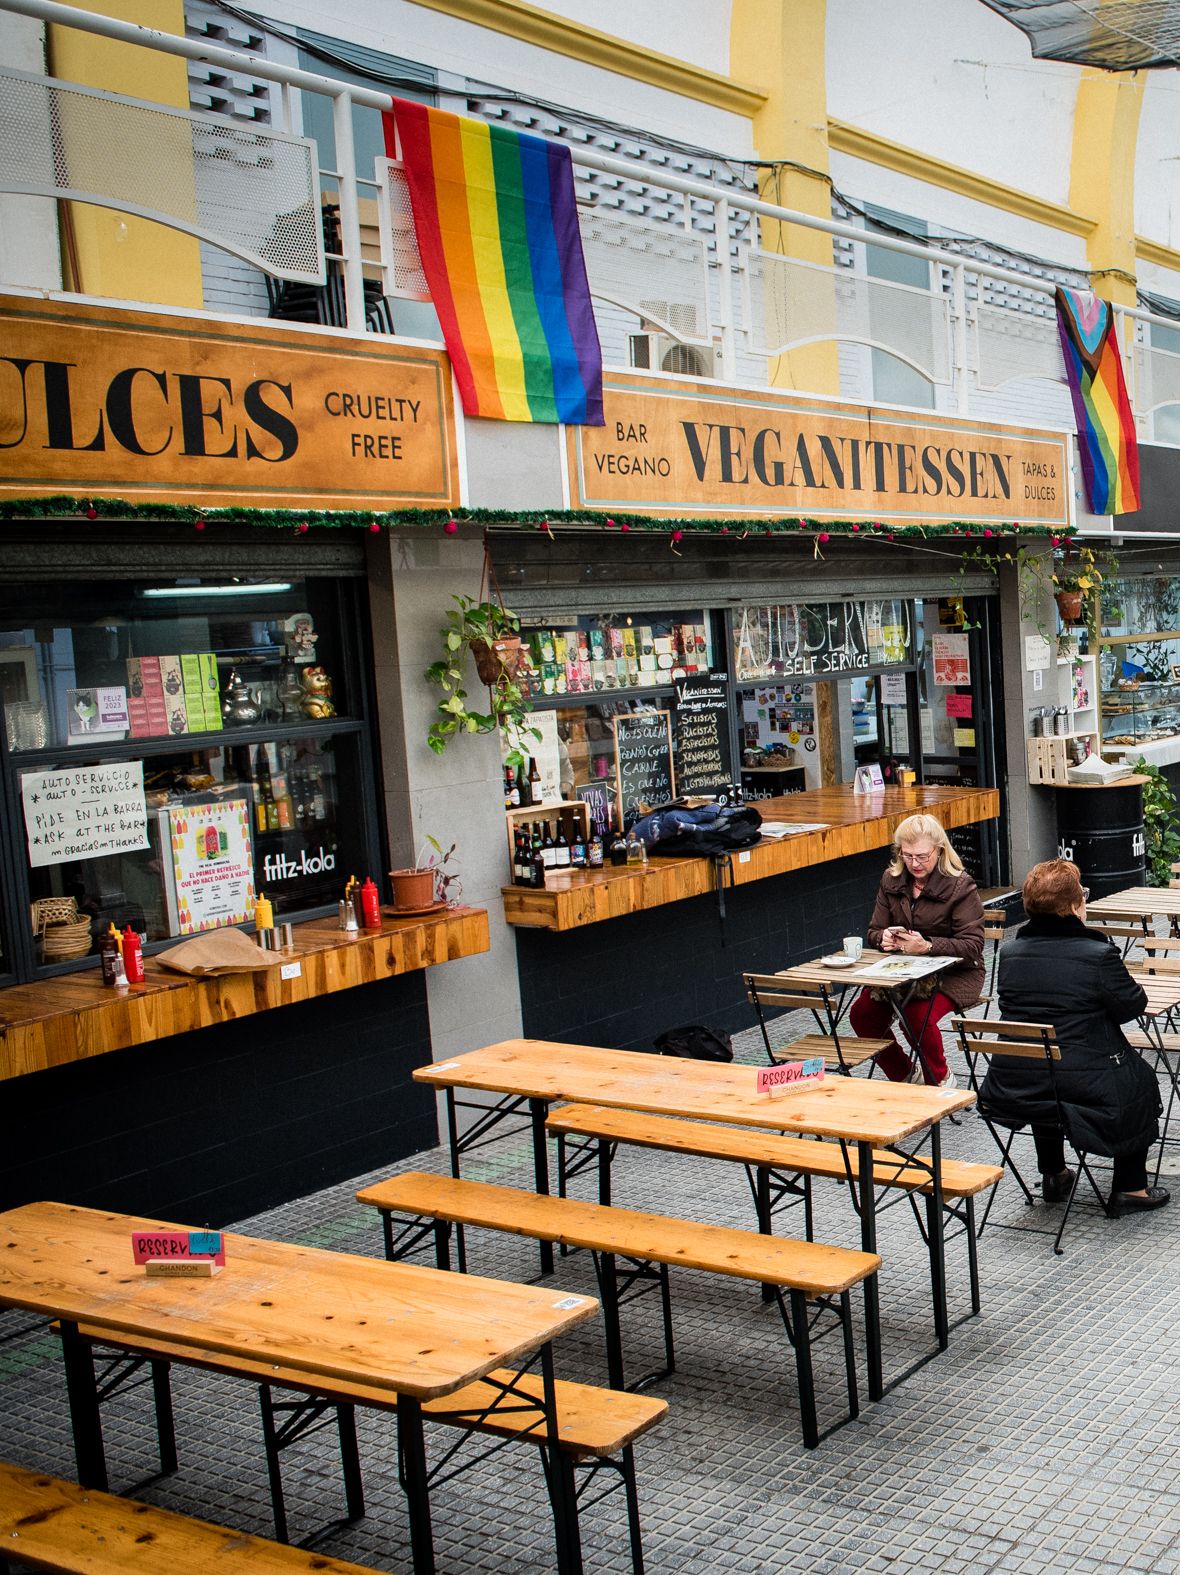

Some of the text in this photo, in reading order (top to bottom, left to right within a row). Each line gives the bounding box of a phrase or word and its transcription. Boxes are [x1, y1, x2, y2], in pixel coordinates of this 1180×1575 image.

[325, 391, 421, 424] CRUELTY
[616, 421, 648, 444] BAR
[351, 434, 403, 461] FREE
[594, 453, 671, 477] VEGANO
[679, 420, 1013, 500] VEGANITESSEN
[1021, 461, 1056, 479] TAPAS &
[1024, 484, 1056, 501] DULCES
[783, 654, 819, 677] SELF
[821, 652, 869, 673] SERVICE
[103, 695, 122, 703] FELIZ
[36, 802, 143, 829] PIDE EN LA BARRA
[44, 830, 65, 845] ASK
[95, 823, 116, 833] THE
[196, 869, 216, 878] PRIMER
[216, 864, 241, 874] REFRESCO
[201, 876, 214, 885] HACE
[214, 873, 230, 882] DAÑO
[235, 869, 250, 878] NADIE
[138, 1238, 216, 1257] RESERV
[159, 1264, 199, 1272] CHANDON
